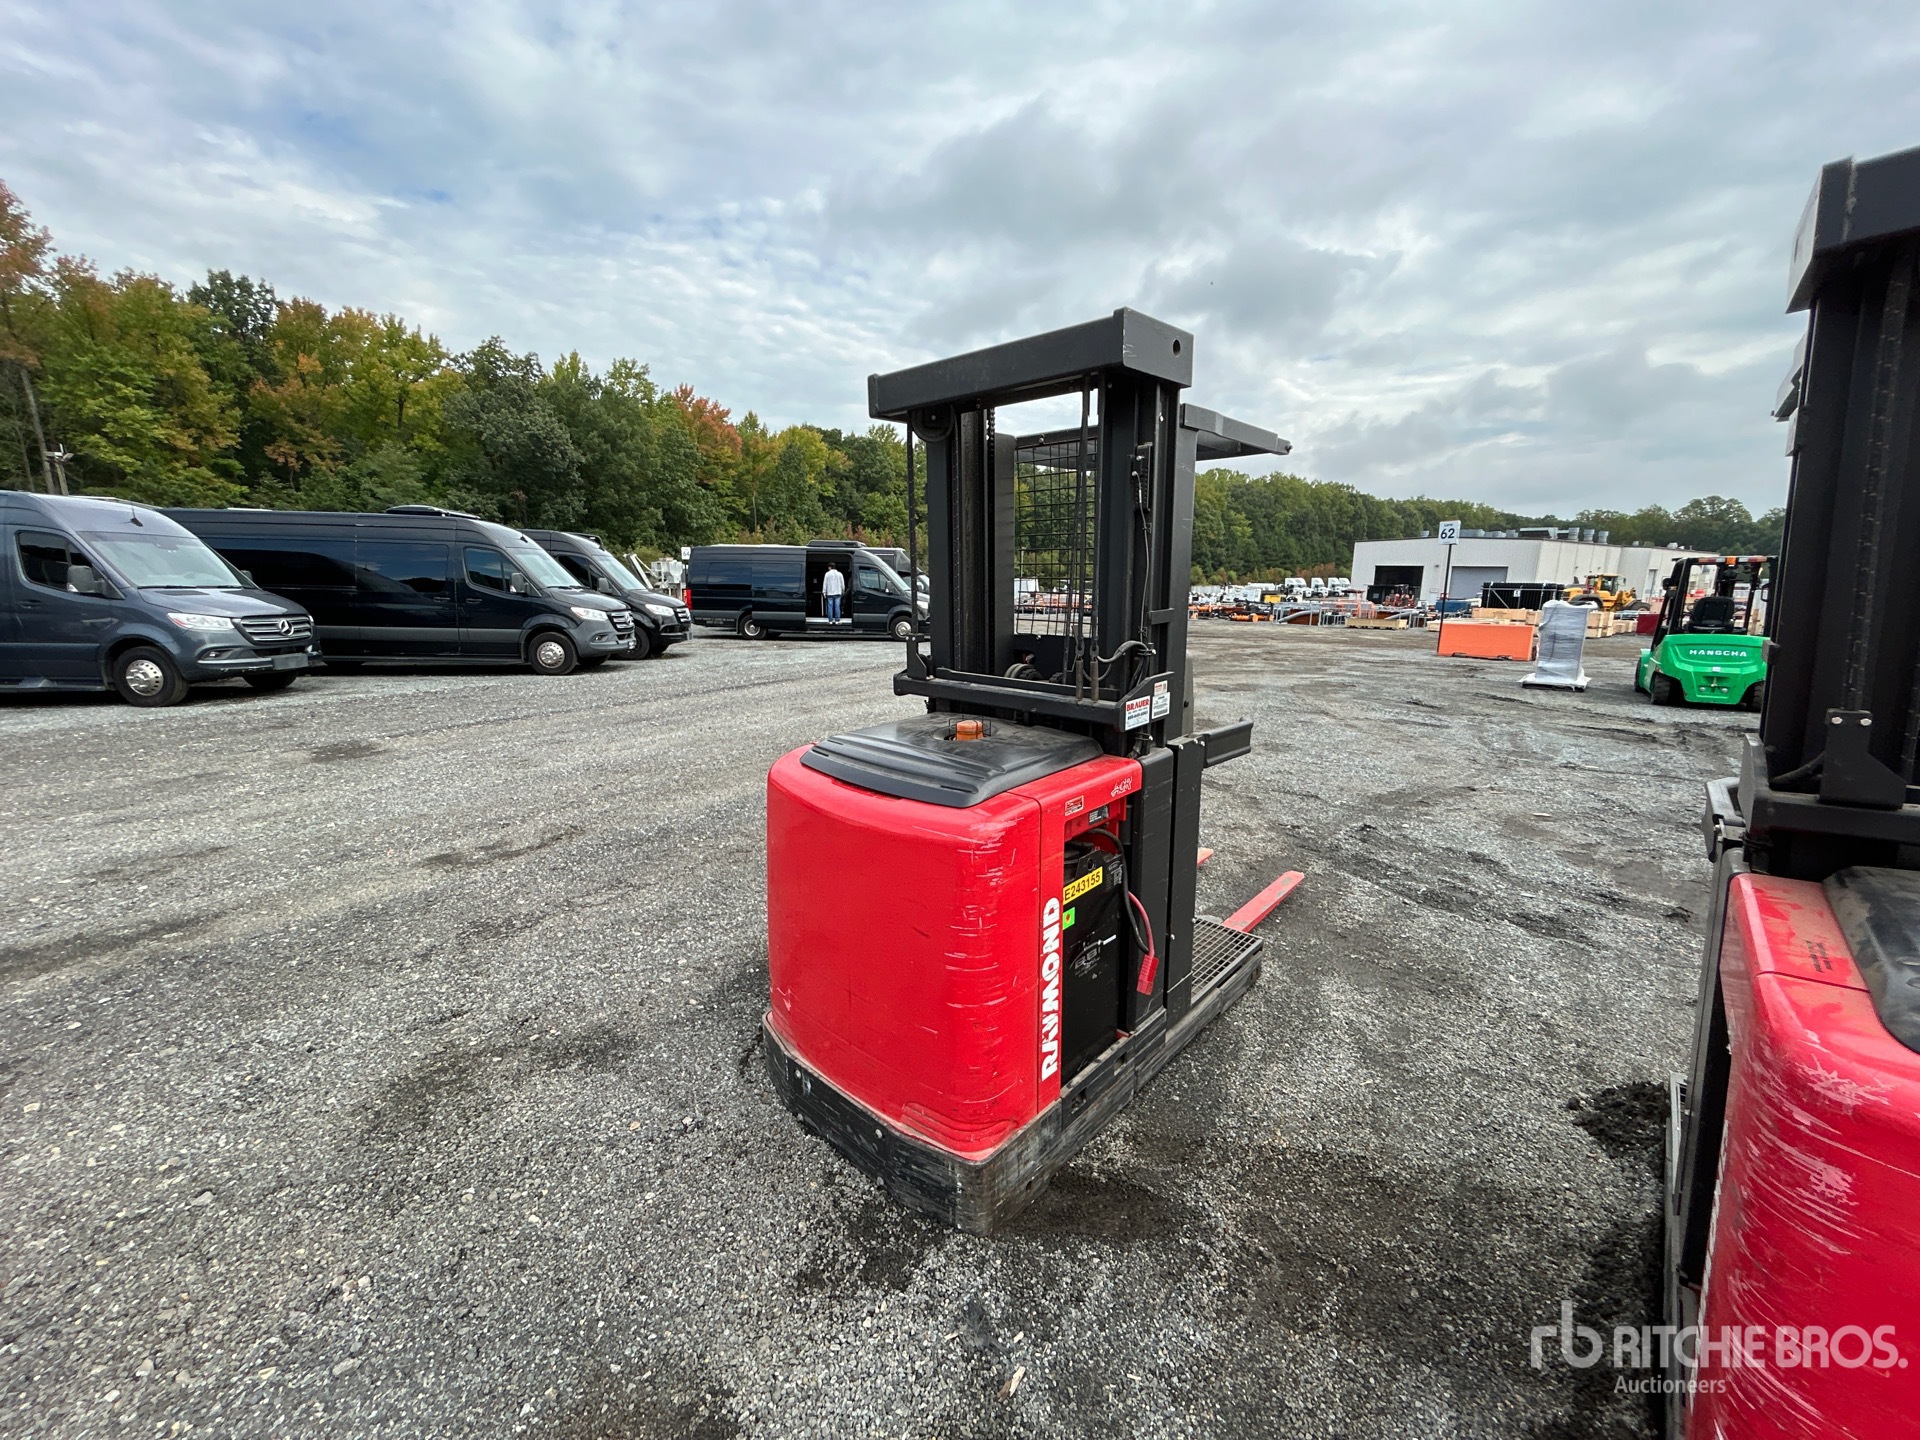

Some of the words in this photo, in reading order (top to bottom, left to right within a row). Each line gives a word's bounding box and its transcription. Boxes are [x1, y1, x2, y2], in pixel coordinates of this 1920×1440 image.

[1440, 528, 1455, 540] 62
[1689, 649, 1747, 657] HANGCHA
[1126, 698, 1150, 712] BRAUER
[1064, 870, 1101, 902] E243155
[1041, 897, 1060, 1082] RAYMOND
